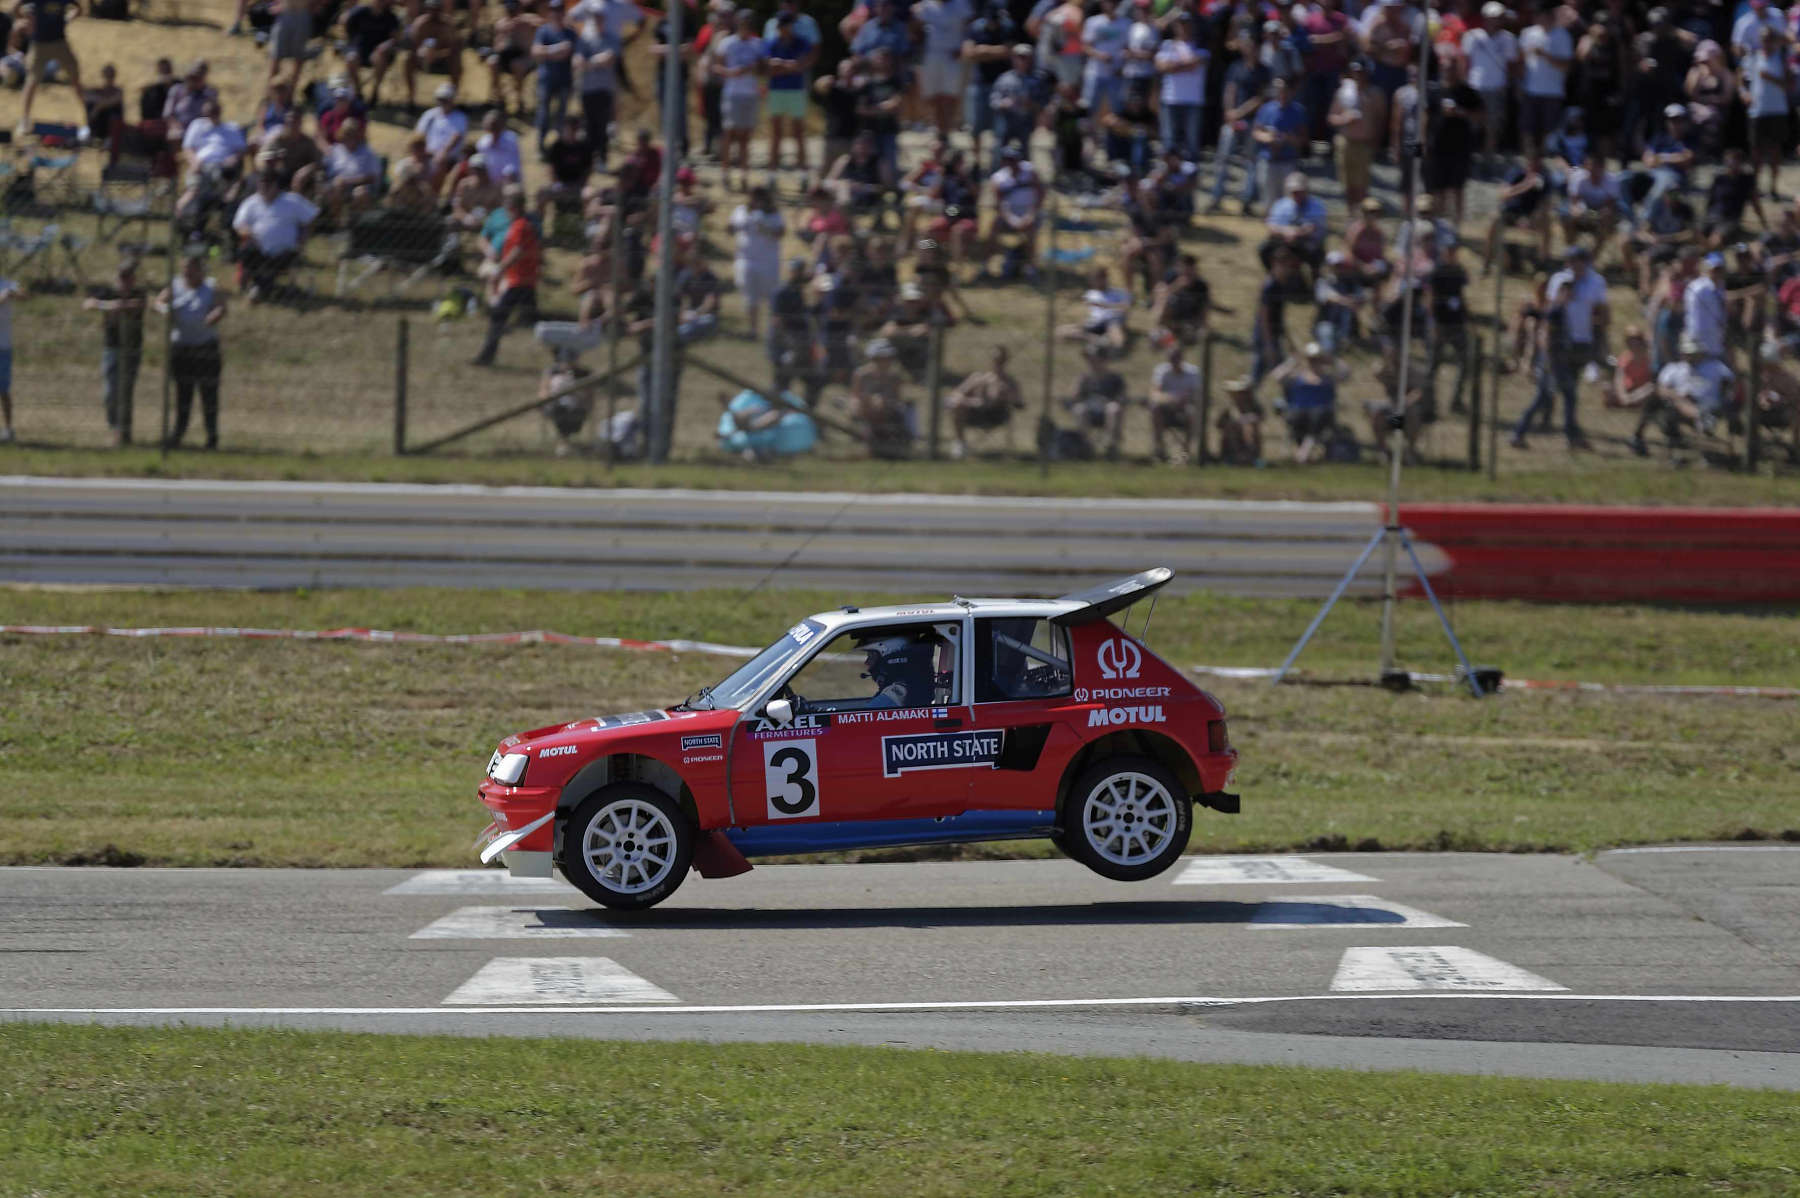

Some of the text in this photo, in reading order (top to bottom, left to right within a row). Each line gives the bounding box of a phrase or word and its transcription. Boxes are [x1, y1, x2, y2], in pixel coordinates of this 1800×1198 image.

[1092, 687, 1171, 699] PIONEER
[756, 715, 822, 731] AXEL
[838, 713, 873, 724] MATTI
[1088, 705, 1166, 727] MOTUL
[754, 728, 824, 740] FERMETURES
[685, 738, 703, 746] NORTH
[539, 745, 577, 759] MOTUL
[892, 738, 999, 761] NORTH STATE
[770, 747, 816, 814] 3
